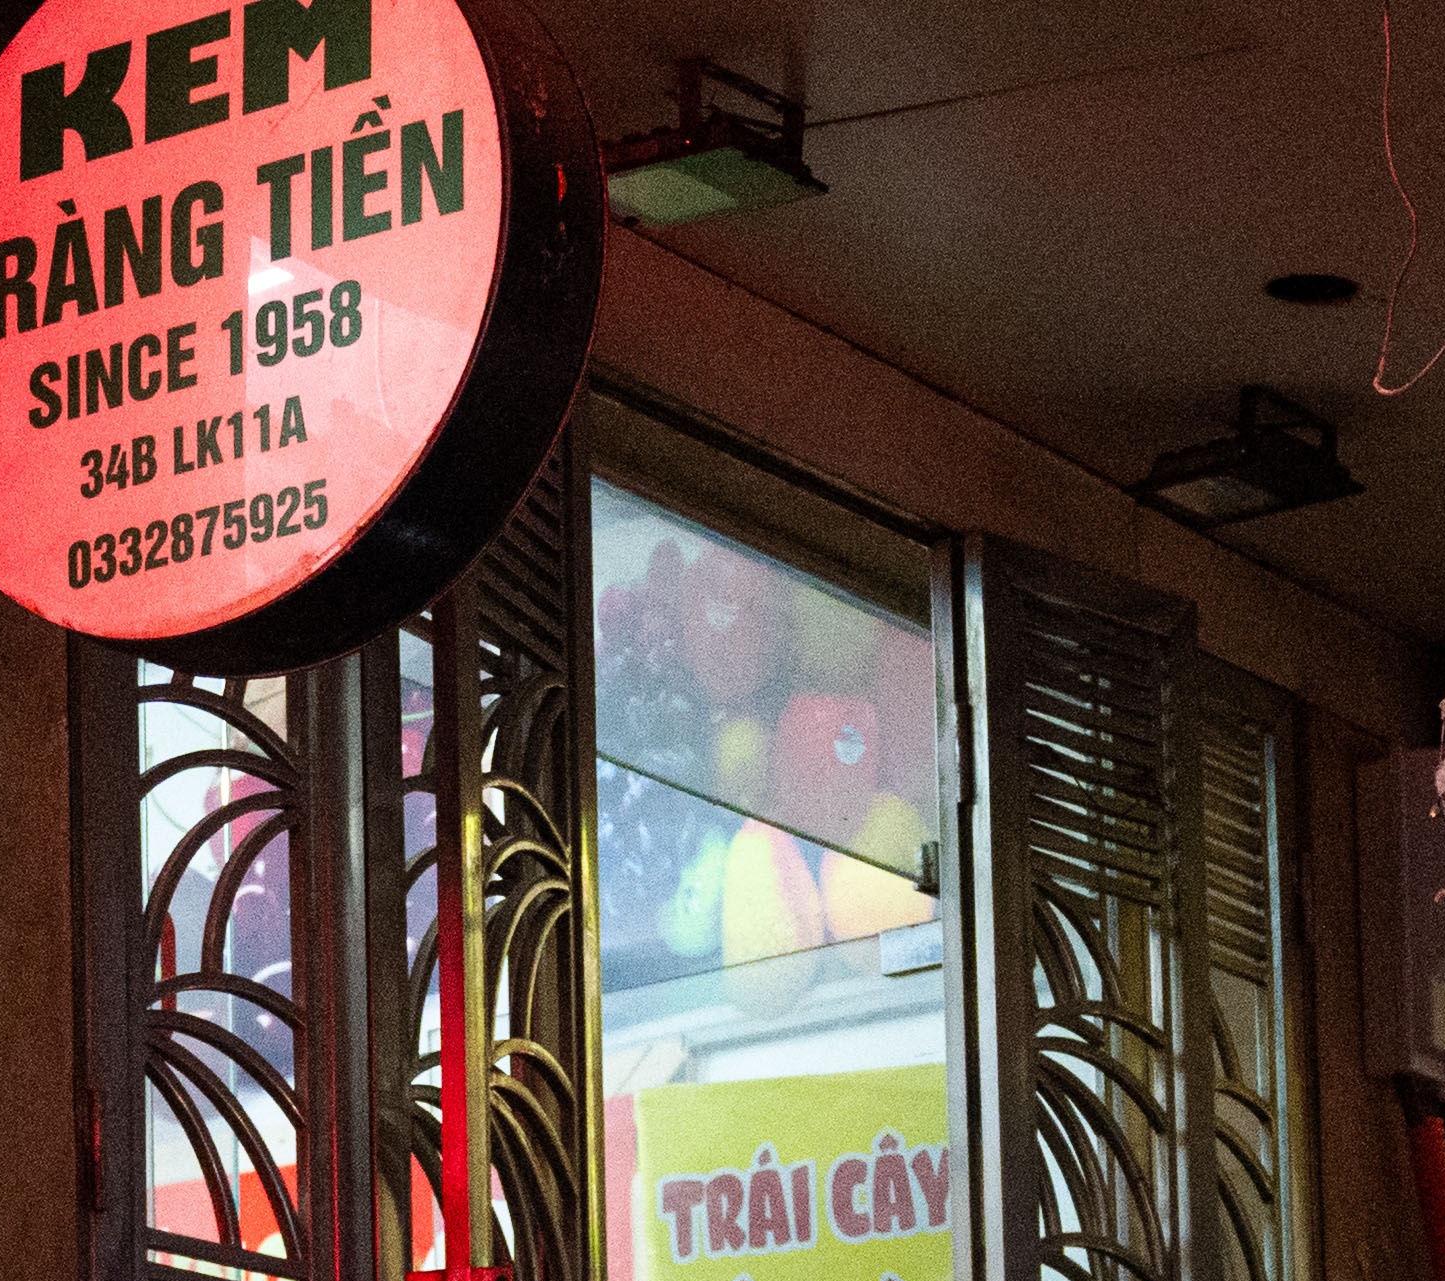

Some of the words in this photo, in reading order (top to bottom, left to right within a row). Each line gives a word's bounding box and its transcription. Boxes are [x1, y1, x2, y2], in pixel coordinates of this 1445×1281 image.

[18, 0, 373, 183] KEM
[256, 94, 465, 263] TIỀN
[28, 321, 199, 431] SINCE
[221, 279, 363, 376] 1958
[79, 438, 158, 500] 34B
[172, 394, 309, 475] LK11A
[67, 478, 329, 591] 0332875925
[661, 1147, 814, 1259] TRÁI
[829, 1131, 951, 1239] CÂY
